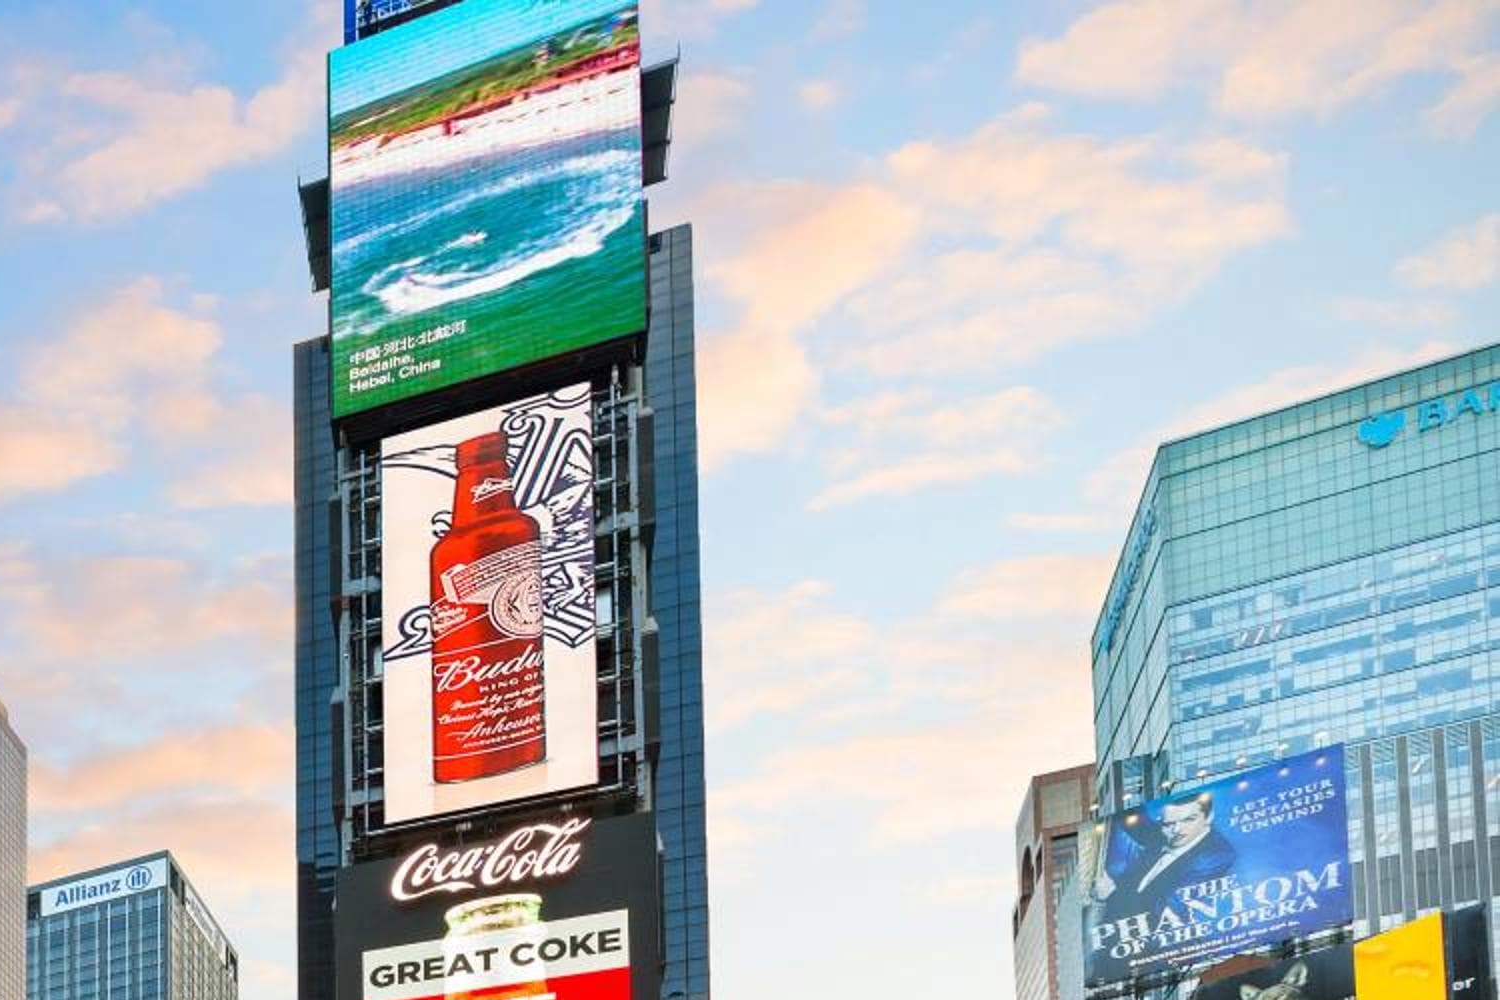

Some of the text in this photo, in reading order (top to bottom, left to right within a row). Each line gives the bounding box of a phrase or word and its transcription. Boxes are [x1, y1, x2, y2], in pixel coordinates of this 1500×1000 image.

[398, 359, 441, 379] China
[1228, 788, 1337, 827] FANTASIES
[1231, 778, 1334, 816] LET YOUR
[1240, 802, 1325, 834] UNWIND
[55, 877, 122, 908] Allianz
[1090, 860, 1345, 953] PHANTOM
[1176, 873, 1240, 906] THE
[1109, 934, 1153, 960] OF
[1151, 918, 1213, 949] THE
[1216, 895, 1319, 932] OPERA
[369, 926, 623, 989] GREAT COKE
